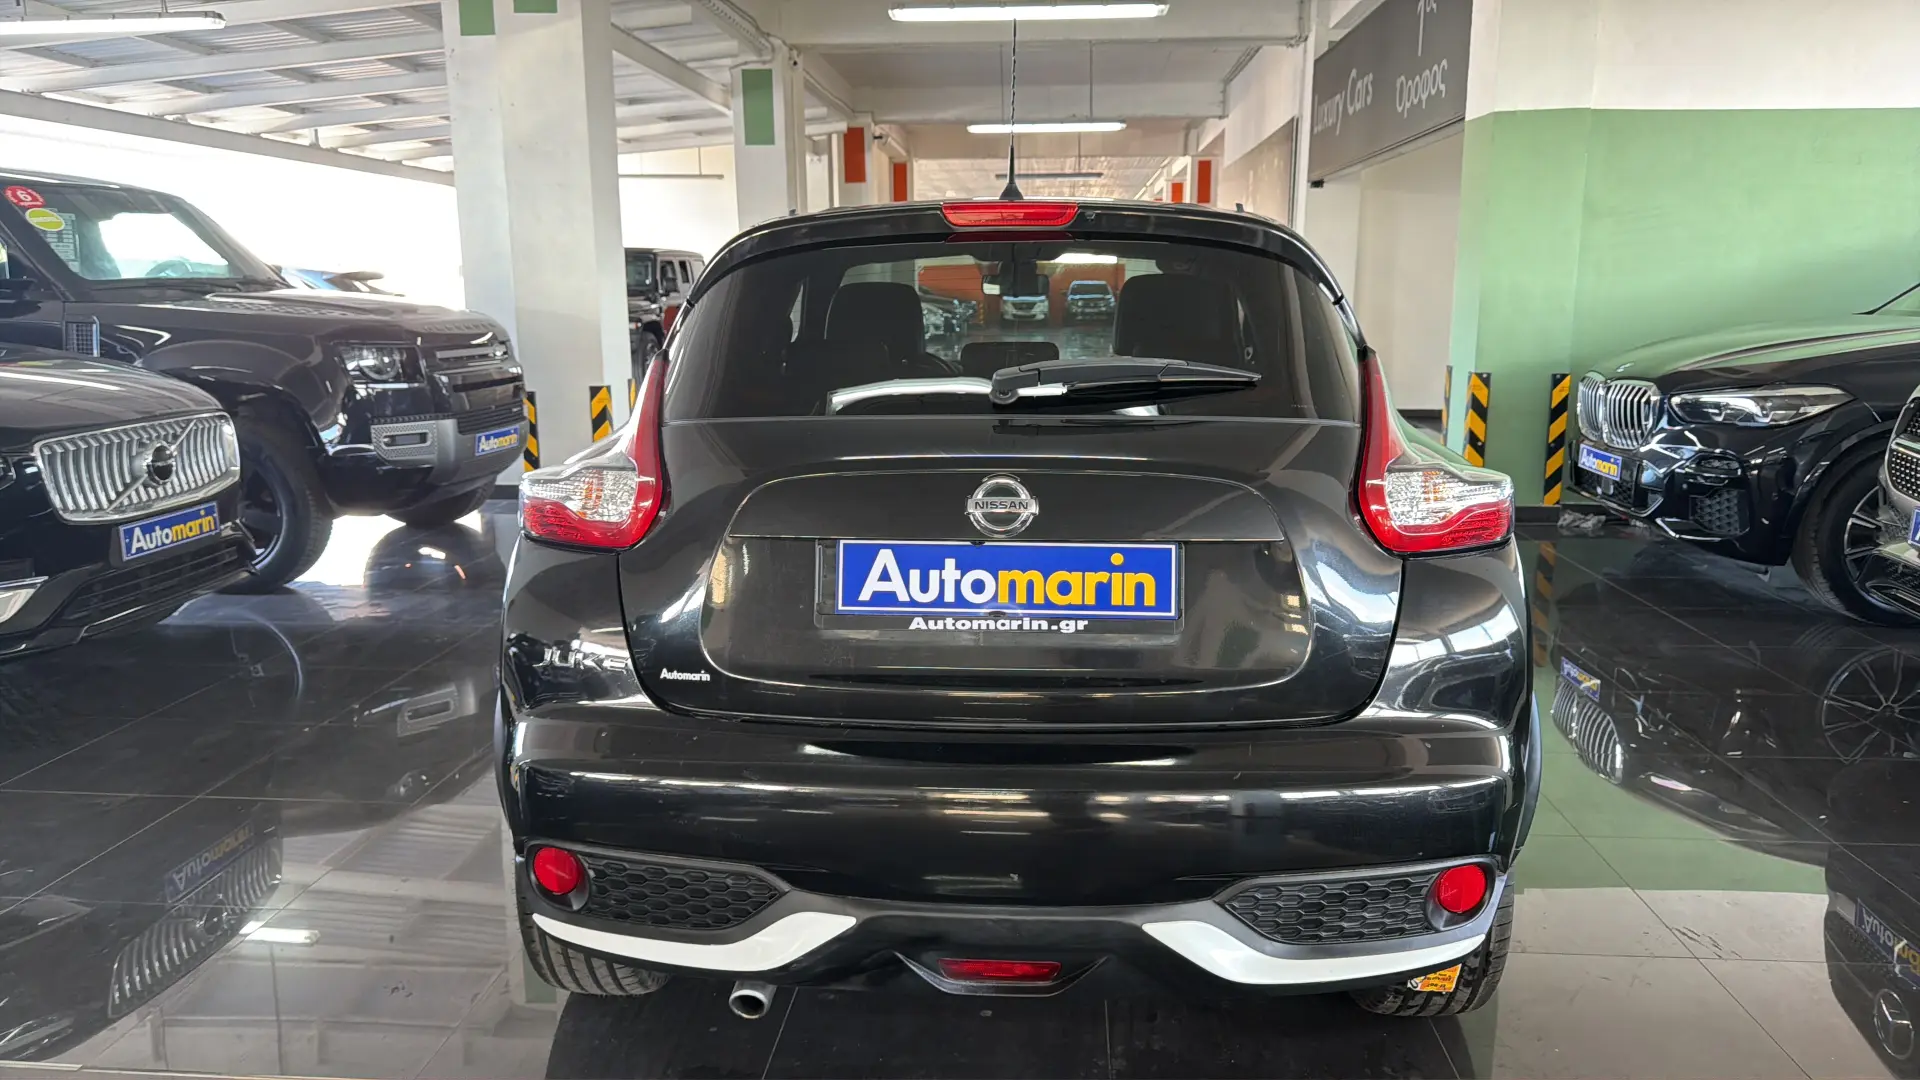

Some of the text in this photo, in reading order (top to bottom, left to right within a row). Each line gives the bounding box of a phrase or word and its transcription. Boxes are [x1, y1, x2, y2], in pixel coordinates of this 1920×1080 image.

[1313, 68, 1373, 136] Luxury Cars
[479, 429, 518, 452] Automarin
[1581, 448, 1618, 477] Automarin
[974, 501, 1029, 510] NISSAN
[131, 510, 215, 554] Automarin
[858, 549, 1156, 606] Automarin
[908, 616, 1089, 633] Automarin.gr
[532, 647, 629, 674] JUKE
[659, 668, 711, 681] Automarin
